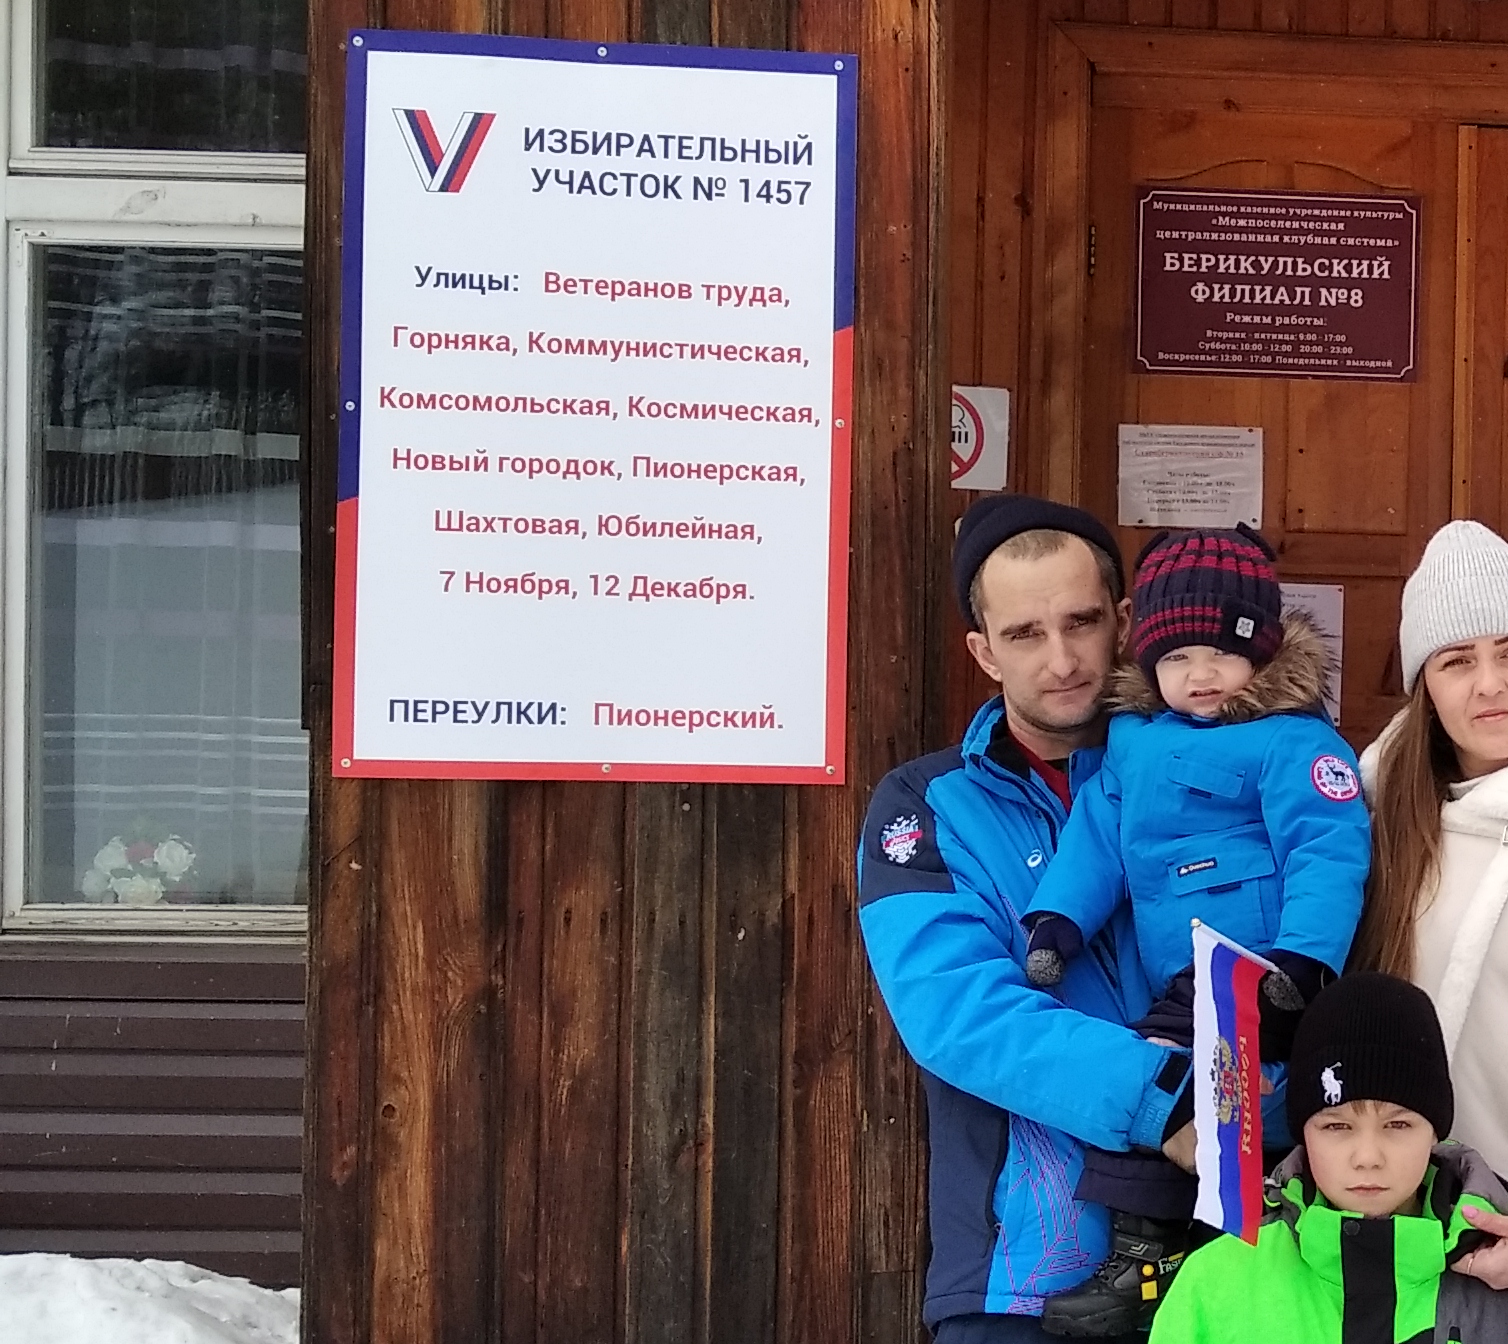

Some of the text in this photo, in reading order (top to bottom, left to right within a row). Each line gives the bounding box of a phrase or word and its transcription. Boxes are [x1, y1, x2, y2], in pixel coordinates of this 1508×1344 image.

[523, 126, 813, 168] ИЗБИРАТЕЛЬНЫЙ
[530, 167, 812, 206] УЧАСТОК № 1457
[1153, 201, 1404, 220] Муниципальное казенное учреждение культуры
[1211, 216, 1346, 230] «Межпоселенческая
[1155, 229, 1400, 247] централизованная клубная система»
[1163, 251, 1392, 280] БЕРИКУЛЬСКИЙ
[414, 265, 790, 308] Улицы: Ветеранов труда,
[1189, 281, 1364, 307] ФИЛИАЛ №8
[1225, 312, 1328, 327] Режим работы:
[393, 325, 809, 368] Горняка, Коммунистическая,
[1198, 341, 1239, 351] Суббота:
[1240, 342, 1263, 351] 10:00
[1270, 344, 1293, 352] 12:00
[1299, 344, 1323, 353] 20:00
[1330, 346, 1353, 354] 23:00
[1206, 329, 1247, 340] Вторник
[1254, 332, 1298, 342] пятница:
[1299, 333, 1318, 342] 9:00
[1324, 334, 1347, 343] 17:00
[1158, 351, 1220, 362] Воскресенье:
[1220, 354, 1243, 362] 12:00
[1250, 355, 1273, 363] 17:00
[1275, 356, 1339, 366] Понедельник
[1345, 359, 1393, 368] выходной
[379, 386, 820, 428] Комсомольская, Космическая,
[392, 447, 806, 487] Новый городок, Пионерская,
[434, 509, 763, 545] Шахтовая, Юбилейная,
[439, 570, 755, 605] 7 Ноября, 12 Декабря.
[389, 699, 784, 734] ПЕРЕУЛКИ: Пионерский.
